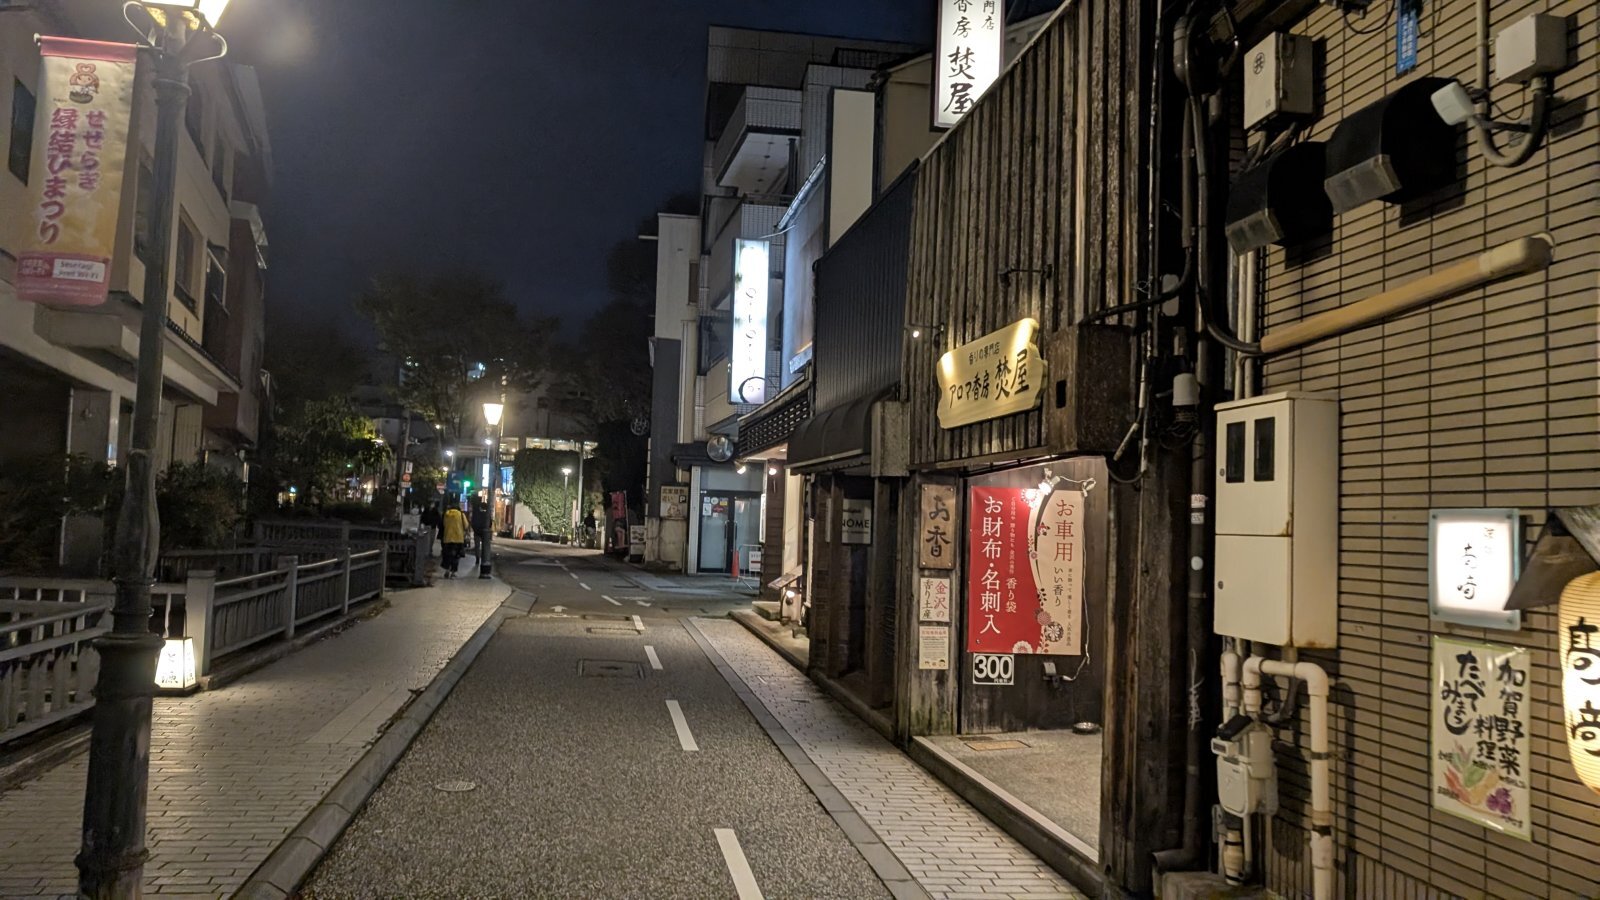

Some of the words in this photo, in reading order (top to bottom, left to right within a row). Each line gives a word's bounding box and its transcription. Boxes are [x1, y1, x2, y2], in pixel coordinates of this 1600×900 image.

[981, 0, 995, 30] 門店
[78, 110, 106, 191] せせらぎ
[39, 108, 79, 245] 縁結びまつり
[949, 369, 990, 409] アロマ香房
[925, 494, 951, 558] お香
[1053, 499, 1075, 563] お車用
[979, 495, 1004, 635] お財布・名刺入
[1052, 566, 1064, 607] いい香り
[922, 579, 934, 620] 香り土産
[934, 580, 948, 618] 金沢の
[1005, 577, 1018, 613] 香り袋
[974, 655, 1012, 679] 300
[1455, 650, 1486, 713] たべて
[1473, 713, 1496, 761] 料理
[1493, 658, 1526, 776] 加賀野菜
